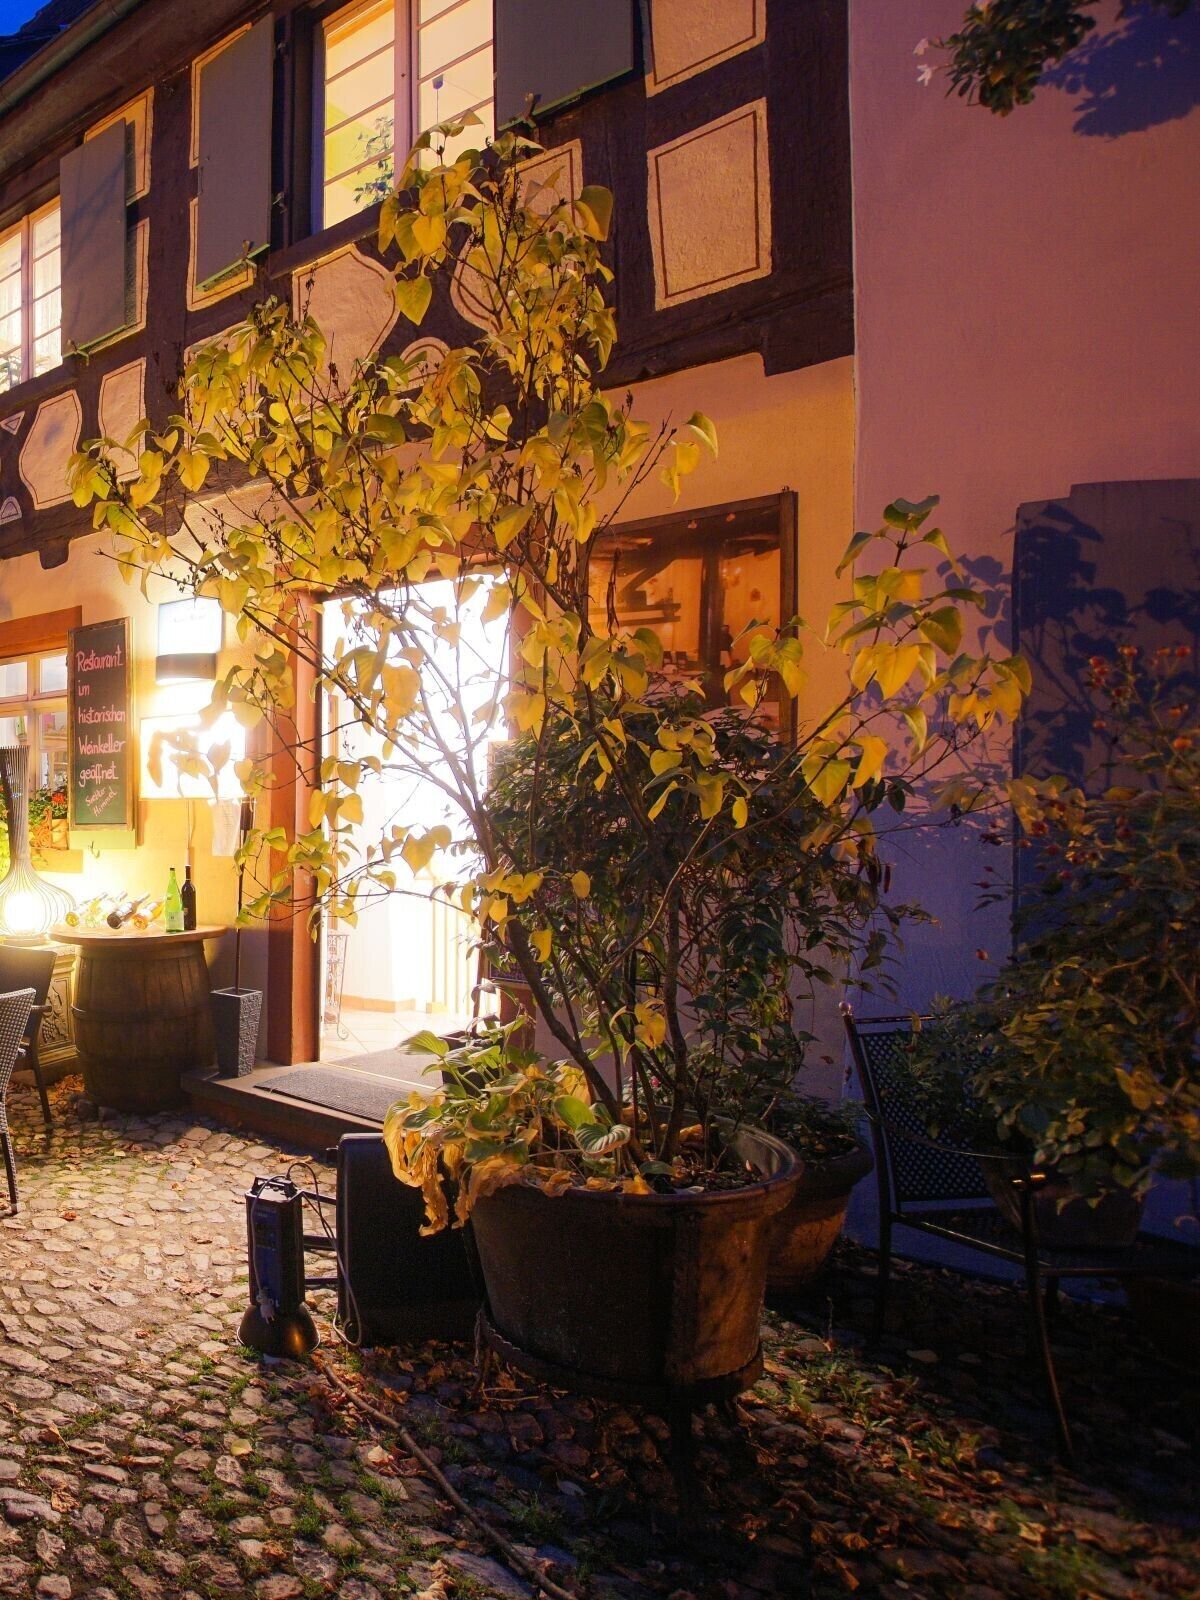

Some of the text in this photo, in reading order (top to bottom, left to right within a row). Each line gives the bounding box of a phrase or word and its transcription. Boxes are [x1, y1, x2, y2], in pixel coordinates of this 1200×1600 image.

[76, 645, 124, 673] Restaurant
[78, 680, 90, 697] im
[78, 704, 126, 725] historischen
[78, 732, 126, 756] Weinkeller
[78, 761, 119, 788] geöffnet
[93, 785, 118, 817] Himmel
